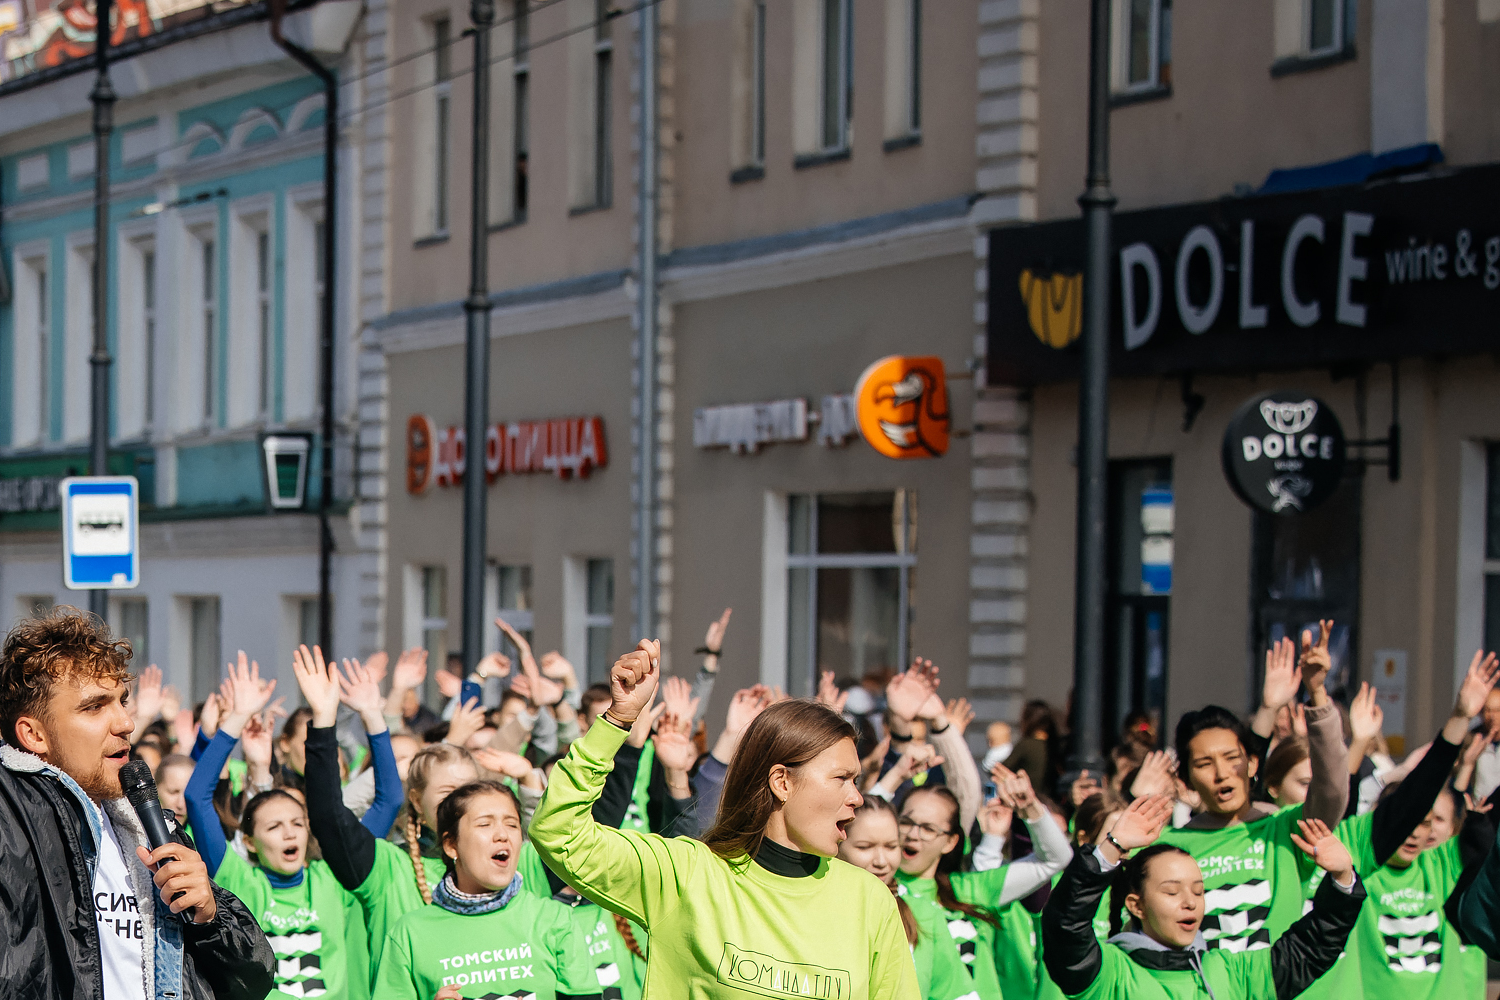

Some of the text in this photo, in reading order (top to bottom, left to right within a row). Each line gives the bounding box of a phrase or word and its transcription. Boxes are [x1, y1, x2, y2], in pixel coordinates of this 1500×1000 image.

[1120, 211, 1375, 351] DOLCE
[1385, 236, 1448, 285] wine
[1454, 228, 1479, 278] &
[1241, 433, 1334, 462] DOLCE
[440, 943, 532, 970] ТОМСКИЙ
[442, 964, 535, 987] ПОЛИТЕХ
